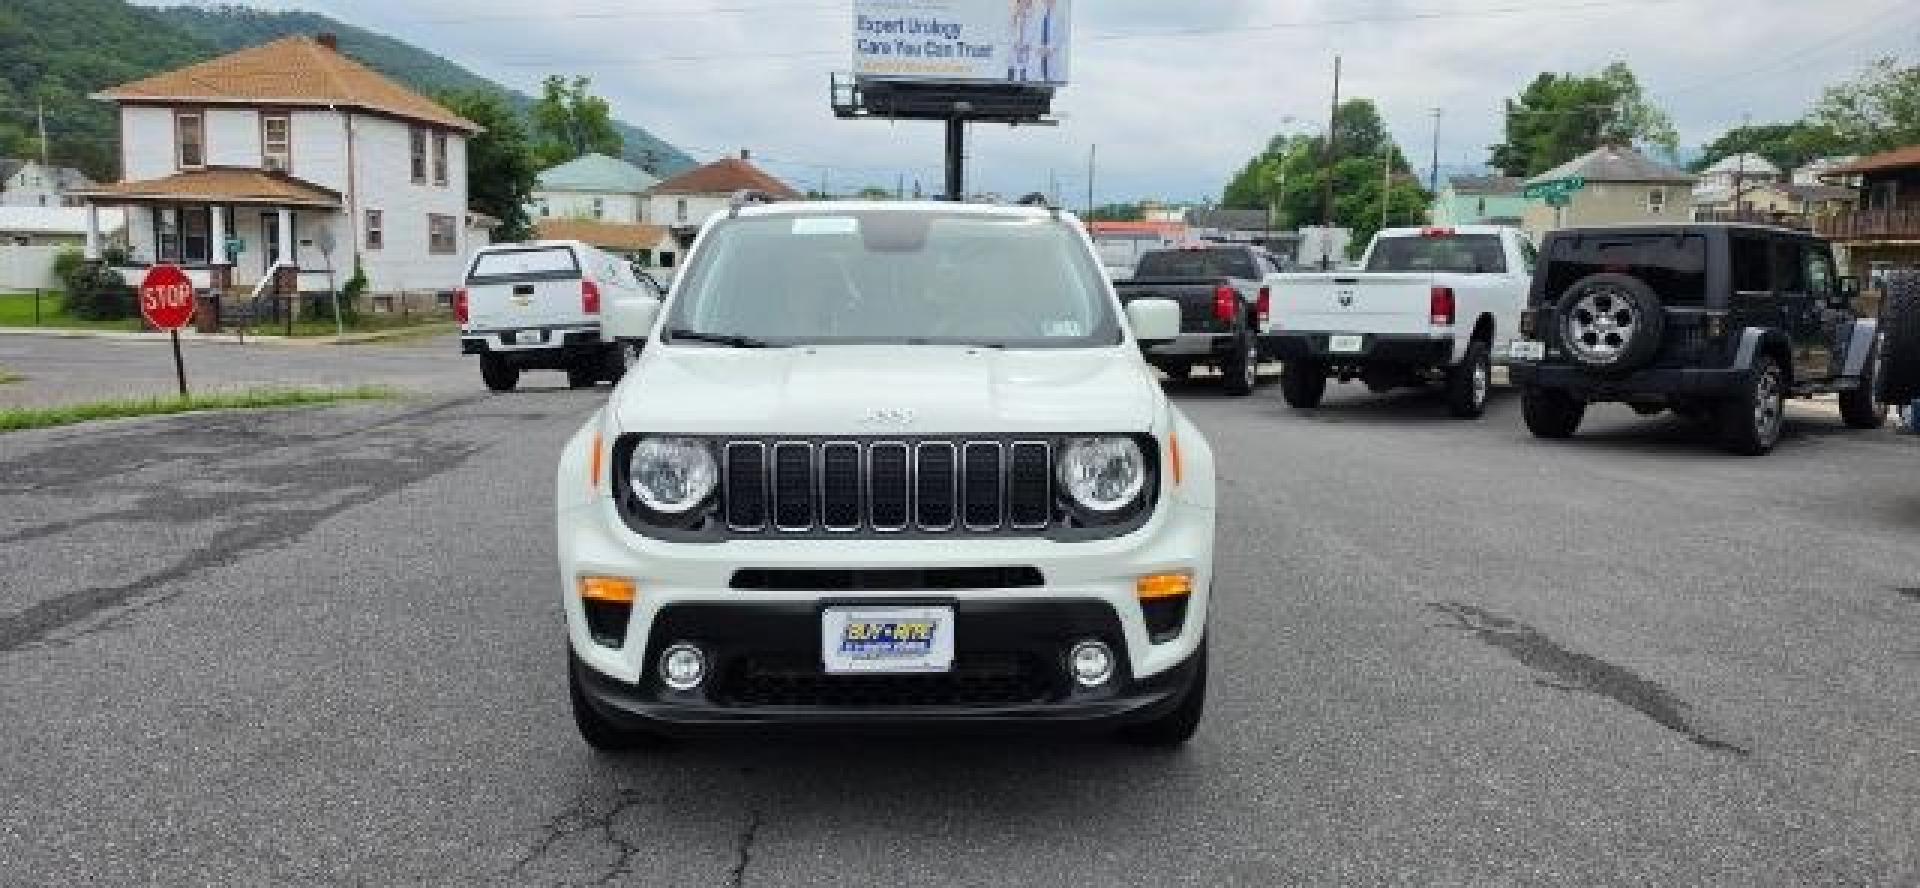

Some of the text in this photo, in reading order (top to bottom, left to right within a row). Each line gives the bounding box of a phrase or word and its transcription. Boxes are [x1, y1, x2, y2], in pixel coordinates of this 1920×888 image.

[858, 15, 962, 39] Expert Urology
[858, 38, 994, 58] Care You Can Trust
[145, 283, 190, 310] STOP
